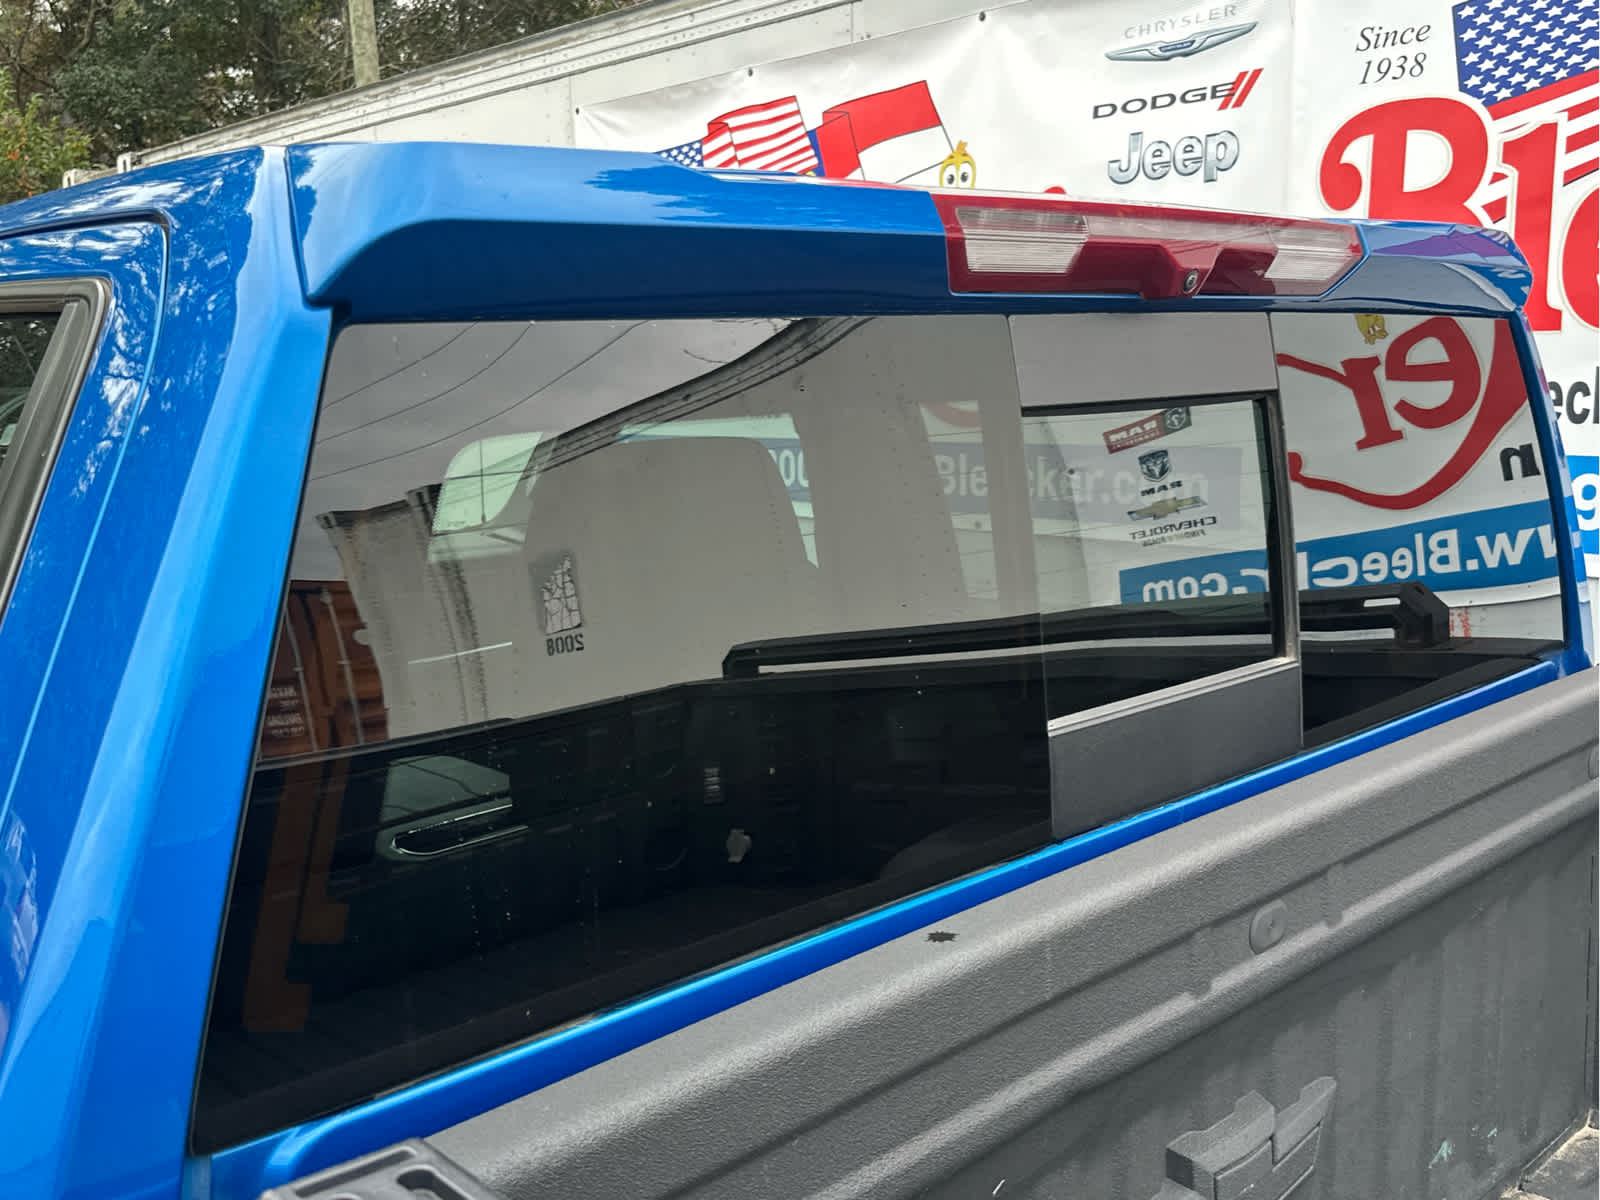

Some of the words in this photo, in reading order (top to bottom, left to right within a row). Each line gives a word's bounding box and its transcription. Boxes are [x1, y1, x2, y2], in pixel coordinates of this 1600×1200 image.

[1124, 4, 1237, 40] CHRYSLER
[1355, 24, 1431, 52] Since
[1359, 52, 1427, 85] 1938
[1092, 81, 1236, 120] DODGE
[1107, 129, 1240, 185] Jeep
